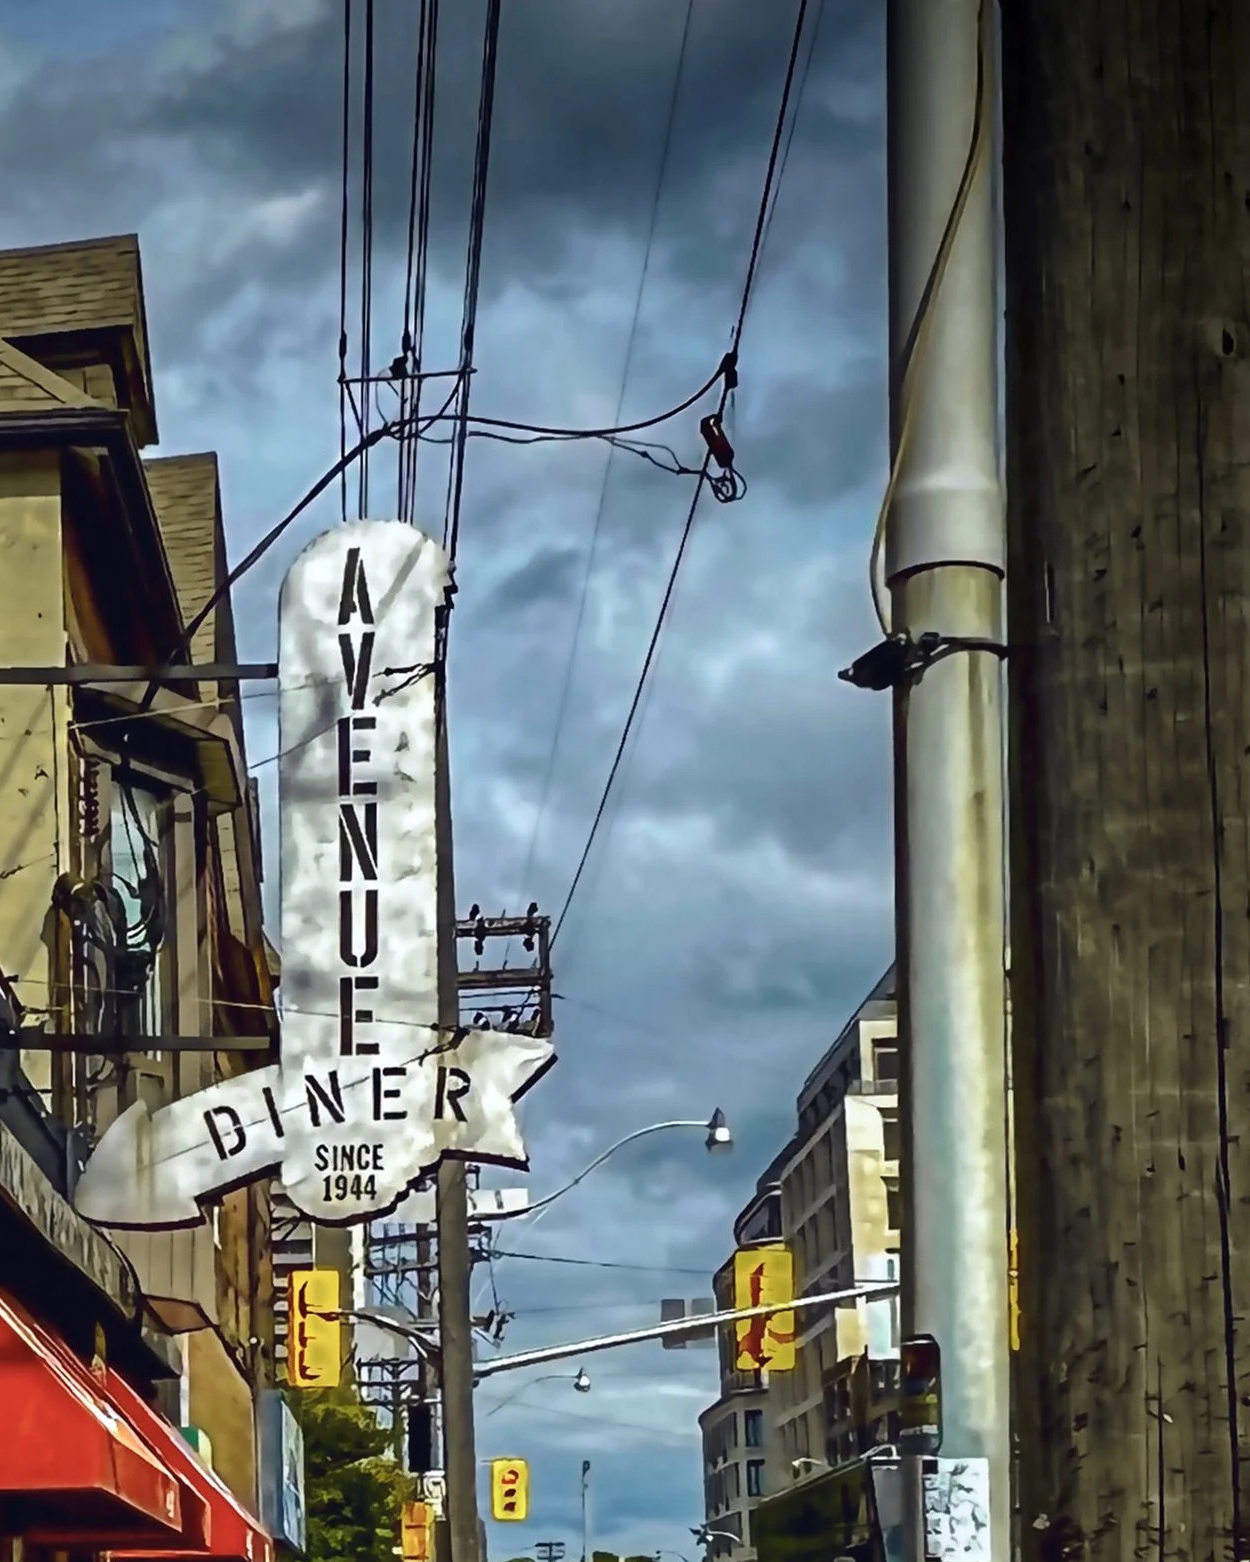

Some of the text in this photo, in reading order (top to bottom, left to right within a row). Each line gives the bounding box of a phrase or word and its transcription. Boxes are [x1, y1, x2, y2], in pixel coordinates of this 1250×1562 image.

[337, 547, 379, 1057] AVENUE
[203, 1066, 472, 1161] DINER
[314, 1143, 385, 1172] SINCE
[322, 1174, 378, 1202] 1944
